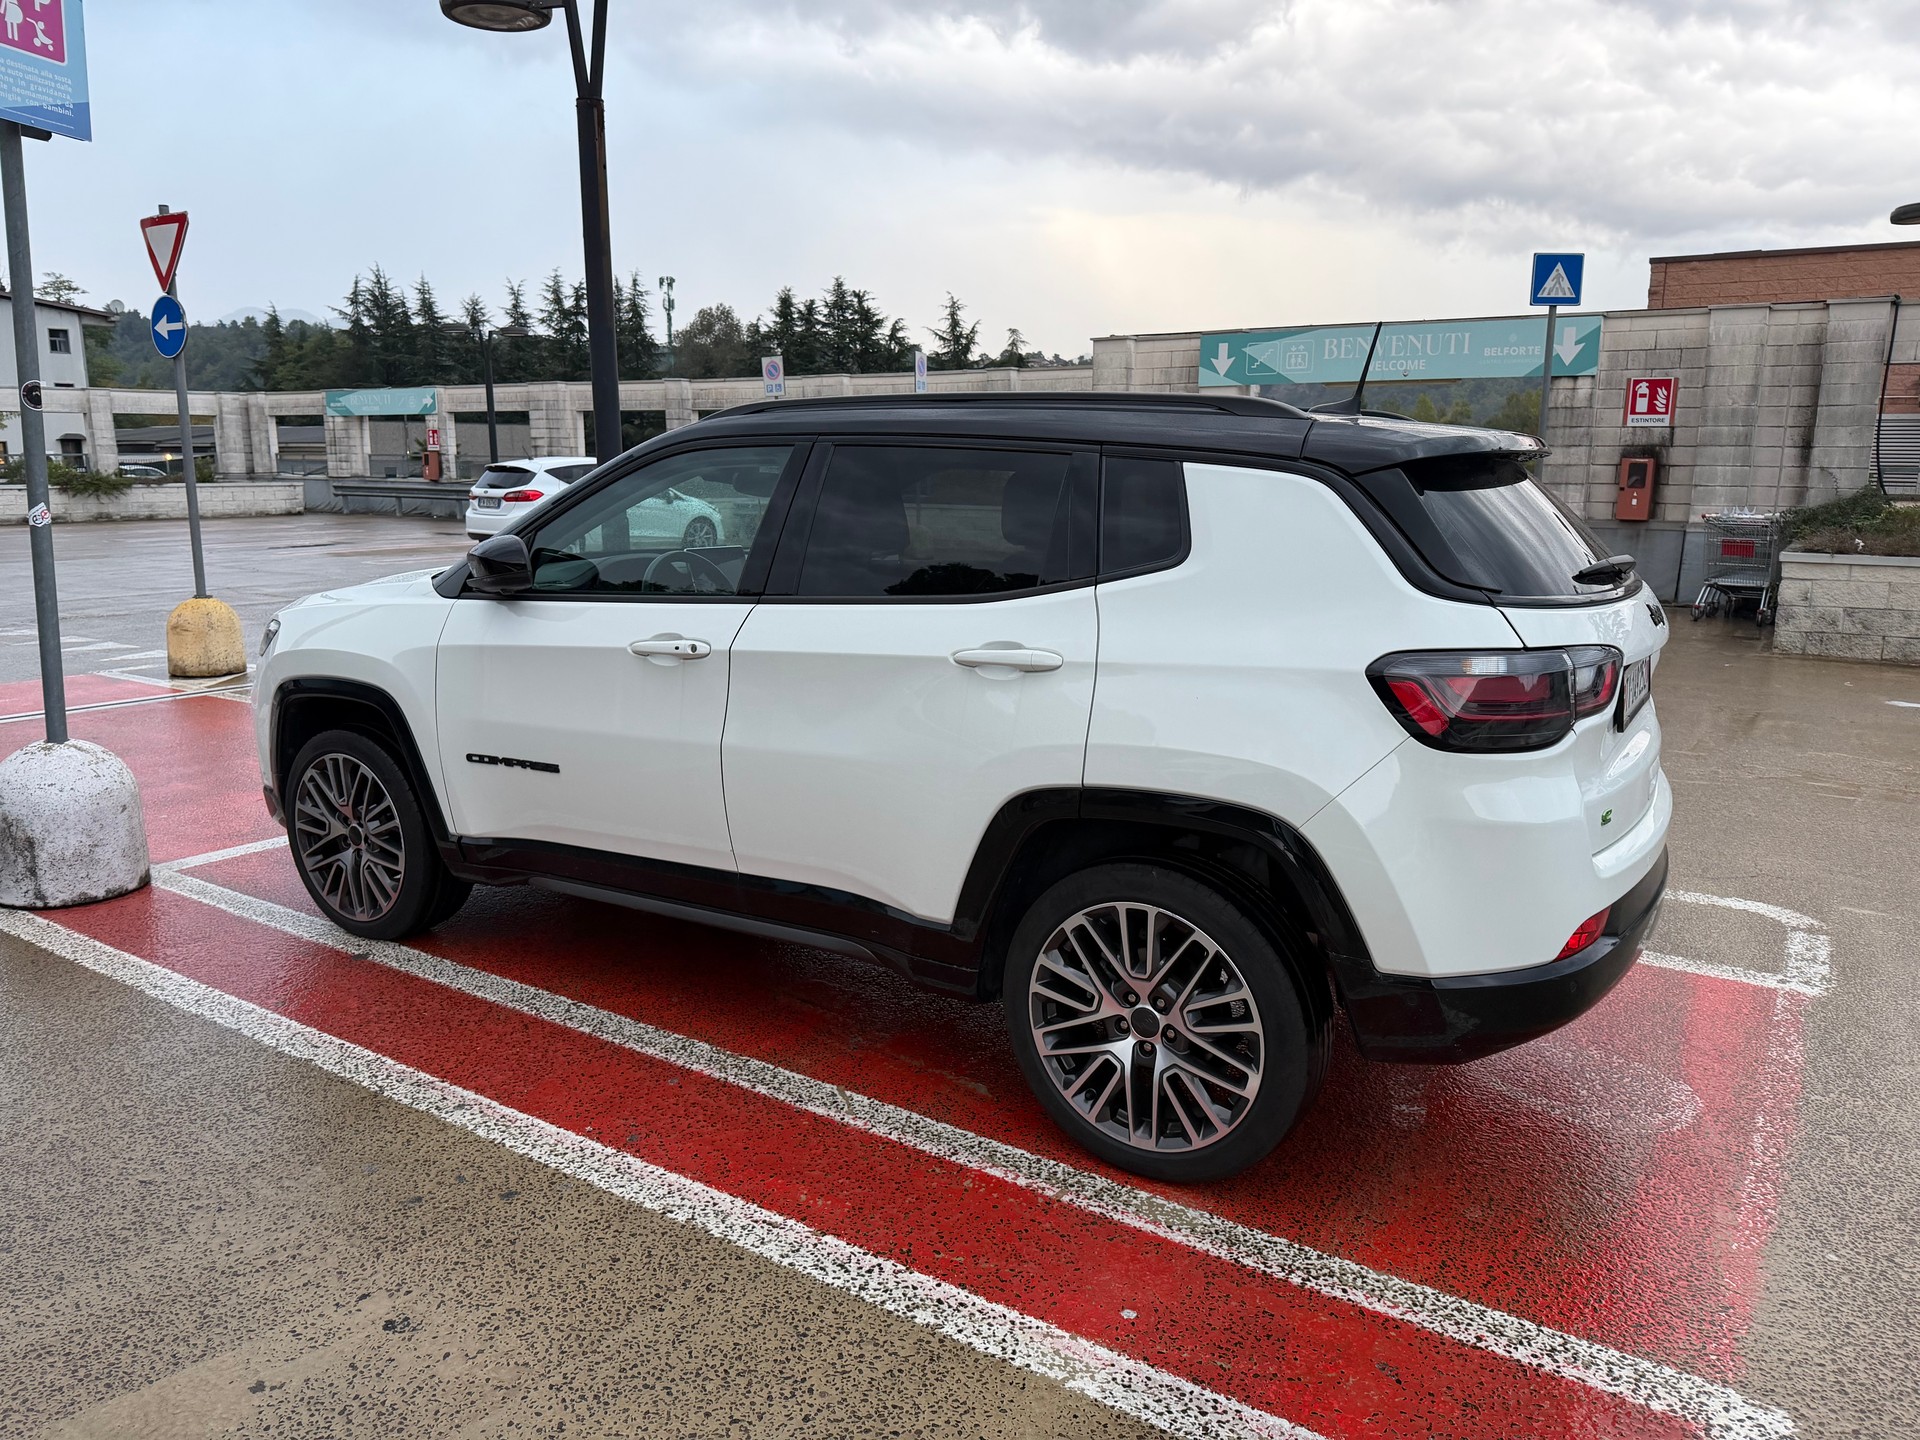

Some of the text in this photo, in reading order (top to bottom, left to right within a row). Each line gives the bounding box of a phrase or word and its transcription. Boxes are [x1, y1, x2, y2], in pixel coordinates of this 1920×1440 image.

[25, 98, 39, 107] con
[42, 102, 74, 117] bambini.
[1322, 332, 1472, 360] BENVENUTI
[1483, 345, 1542, 357] BELFORTE
